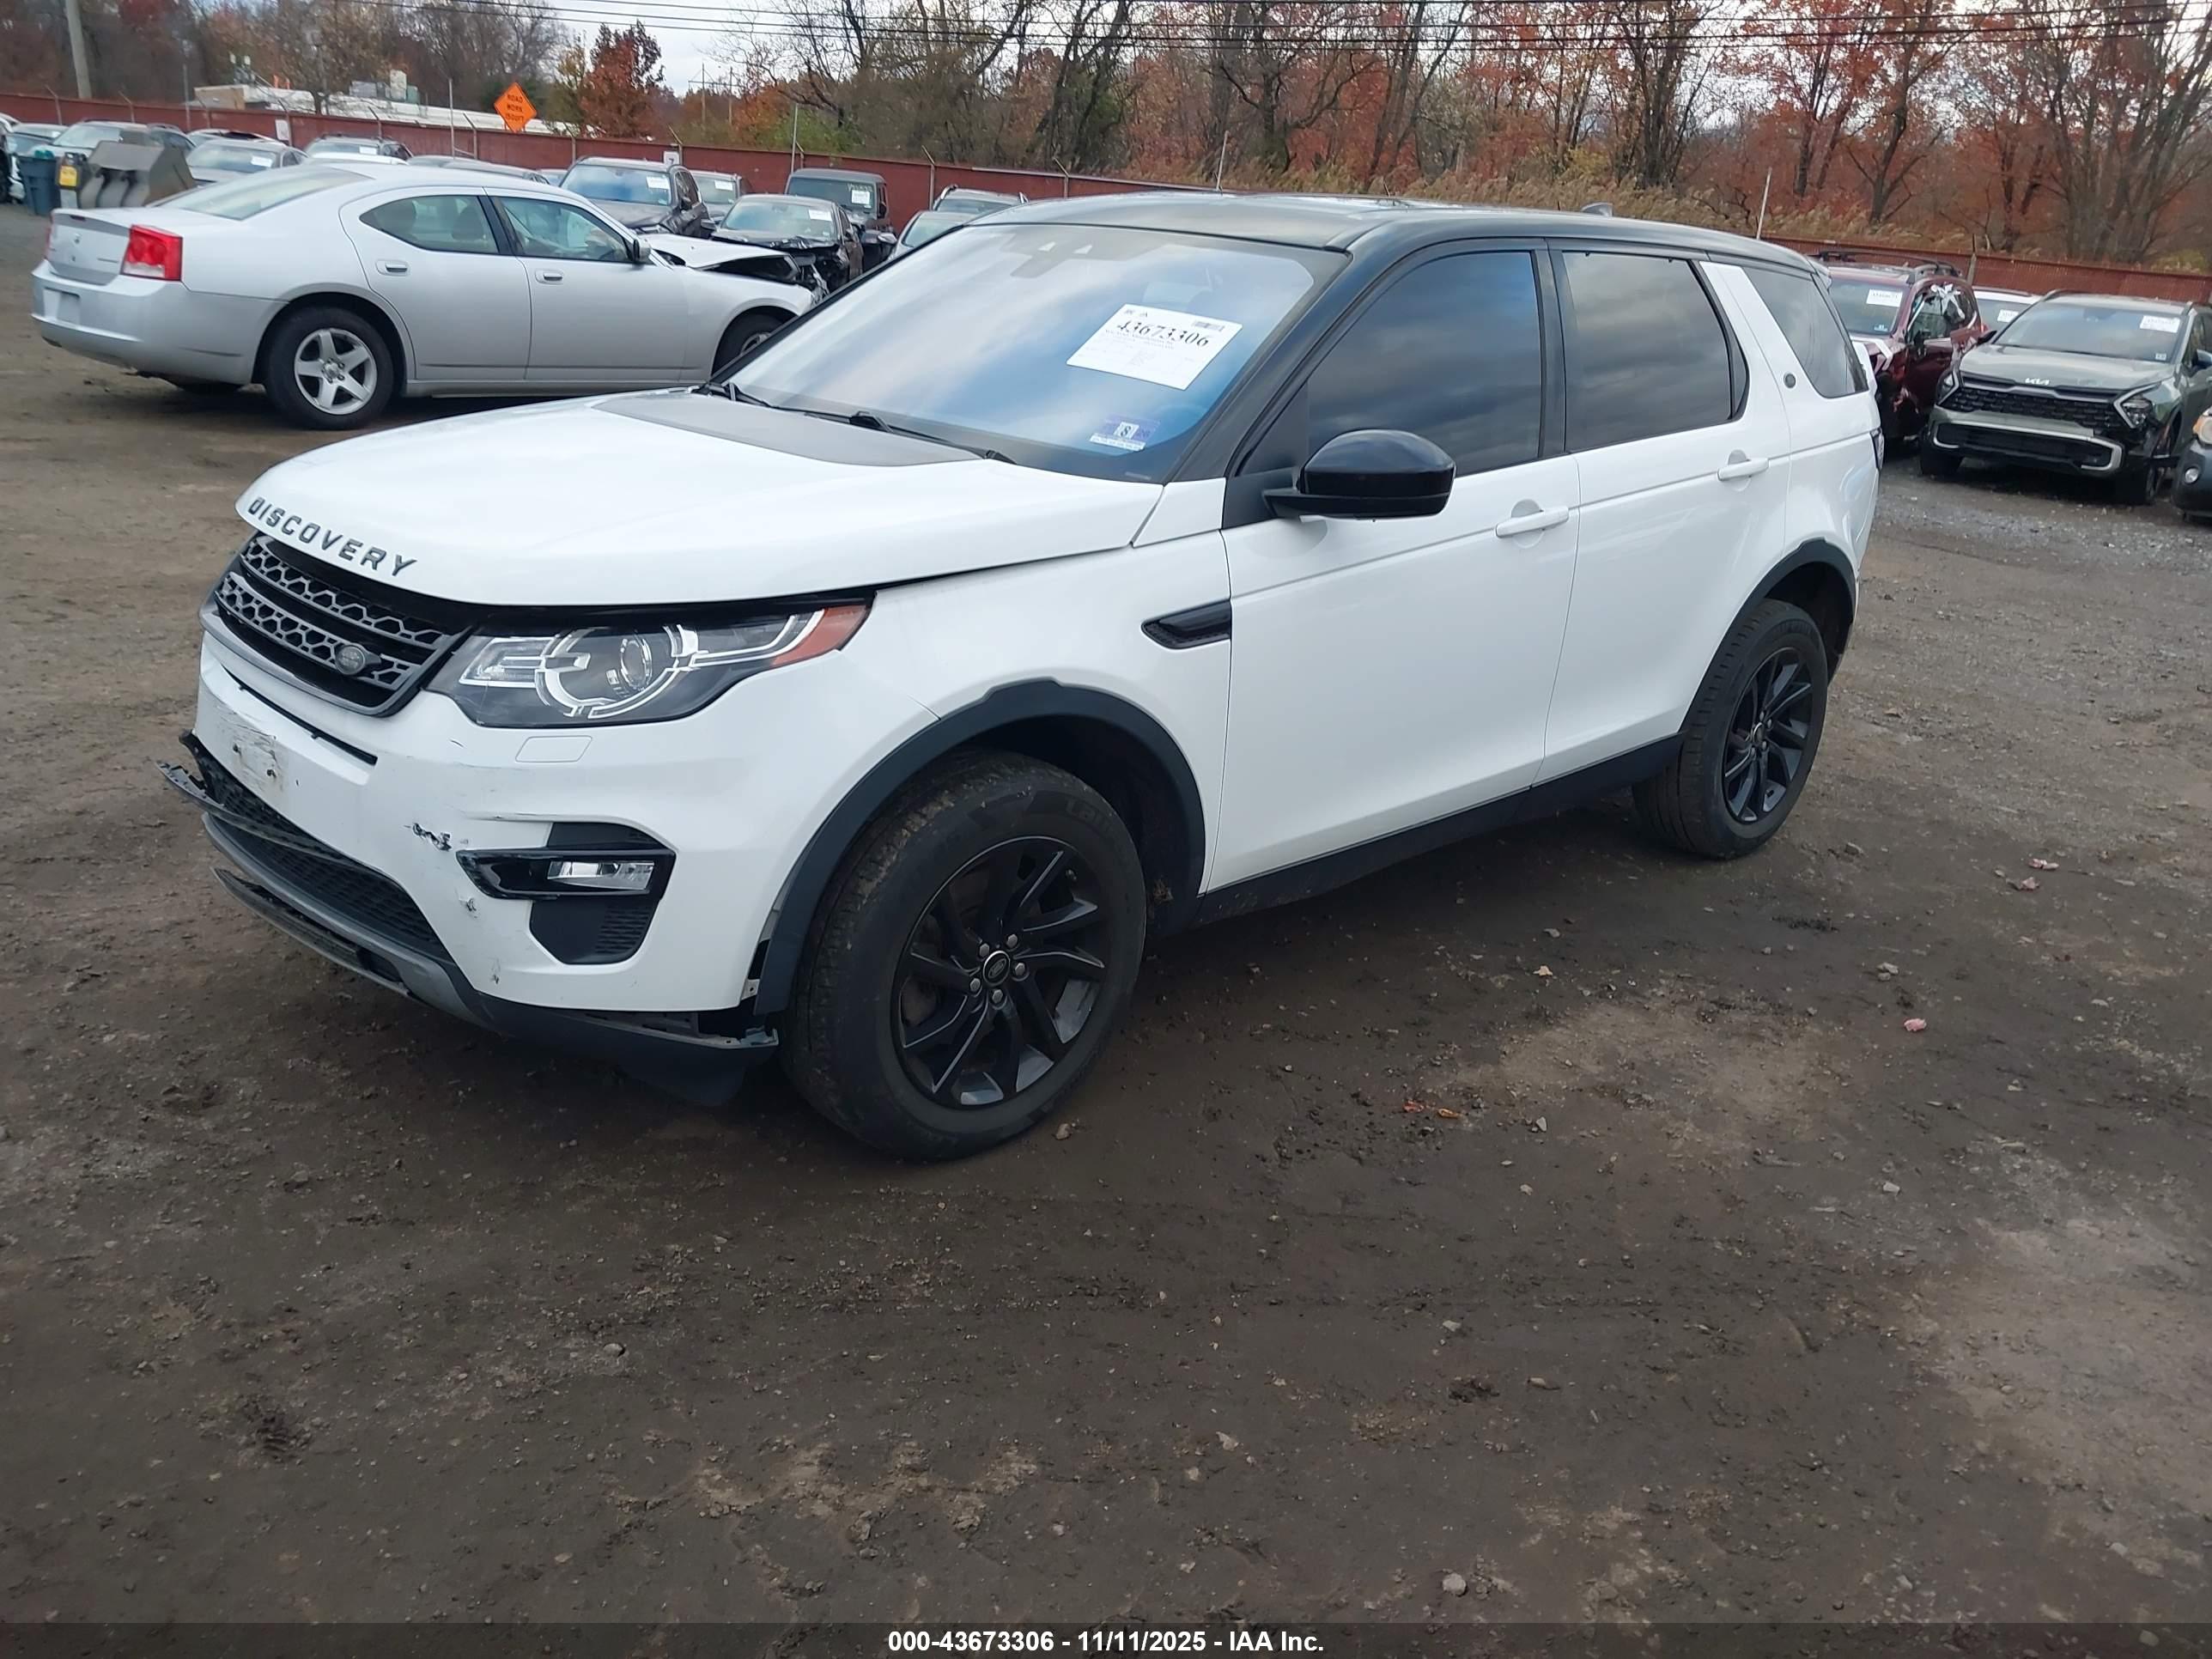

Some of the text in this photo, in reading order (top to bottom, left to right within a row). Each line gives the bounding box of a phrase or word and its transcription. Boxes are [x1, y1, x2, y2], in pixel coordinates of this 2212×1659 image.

[507, 94, 524, 103] ROAD
[507, 103, 523, 112] WORK
[1117, 319, 1212, 347] 43673306
[247, 496, 417, 576] DISCOVERY
